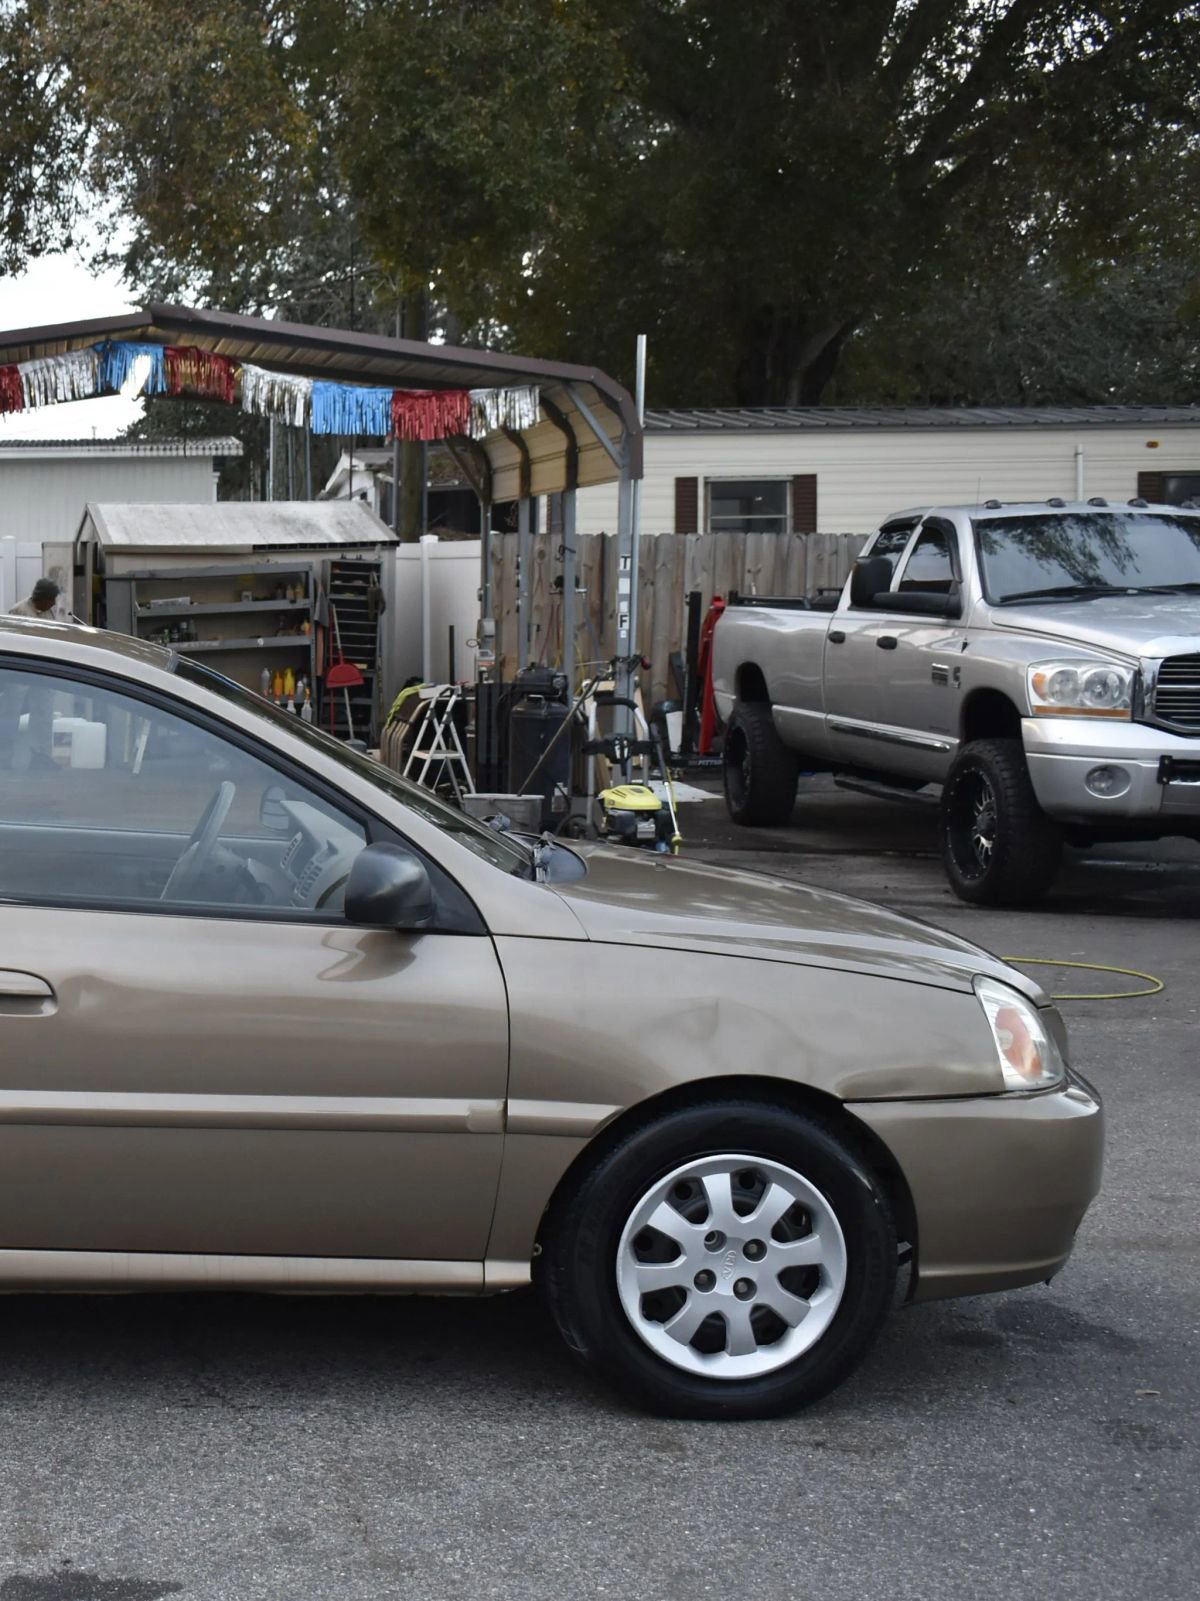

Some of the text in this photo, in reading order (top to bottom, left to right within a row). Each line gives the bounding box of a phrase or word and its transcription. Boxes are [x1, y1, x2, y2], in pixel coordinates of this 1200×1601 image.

[620, 555, 631, 570] T
[619, 614, 628, 629] F
[721, 1252, 737, 1278] KIA
